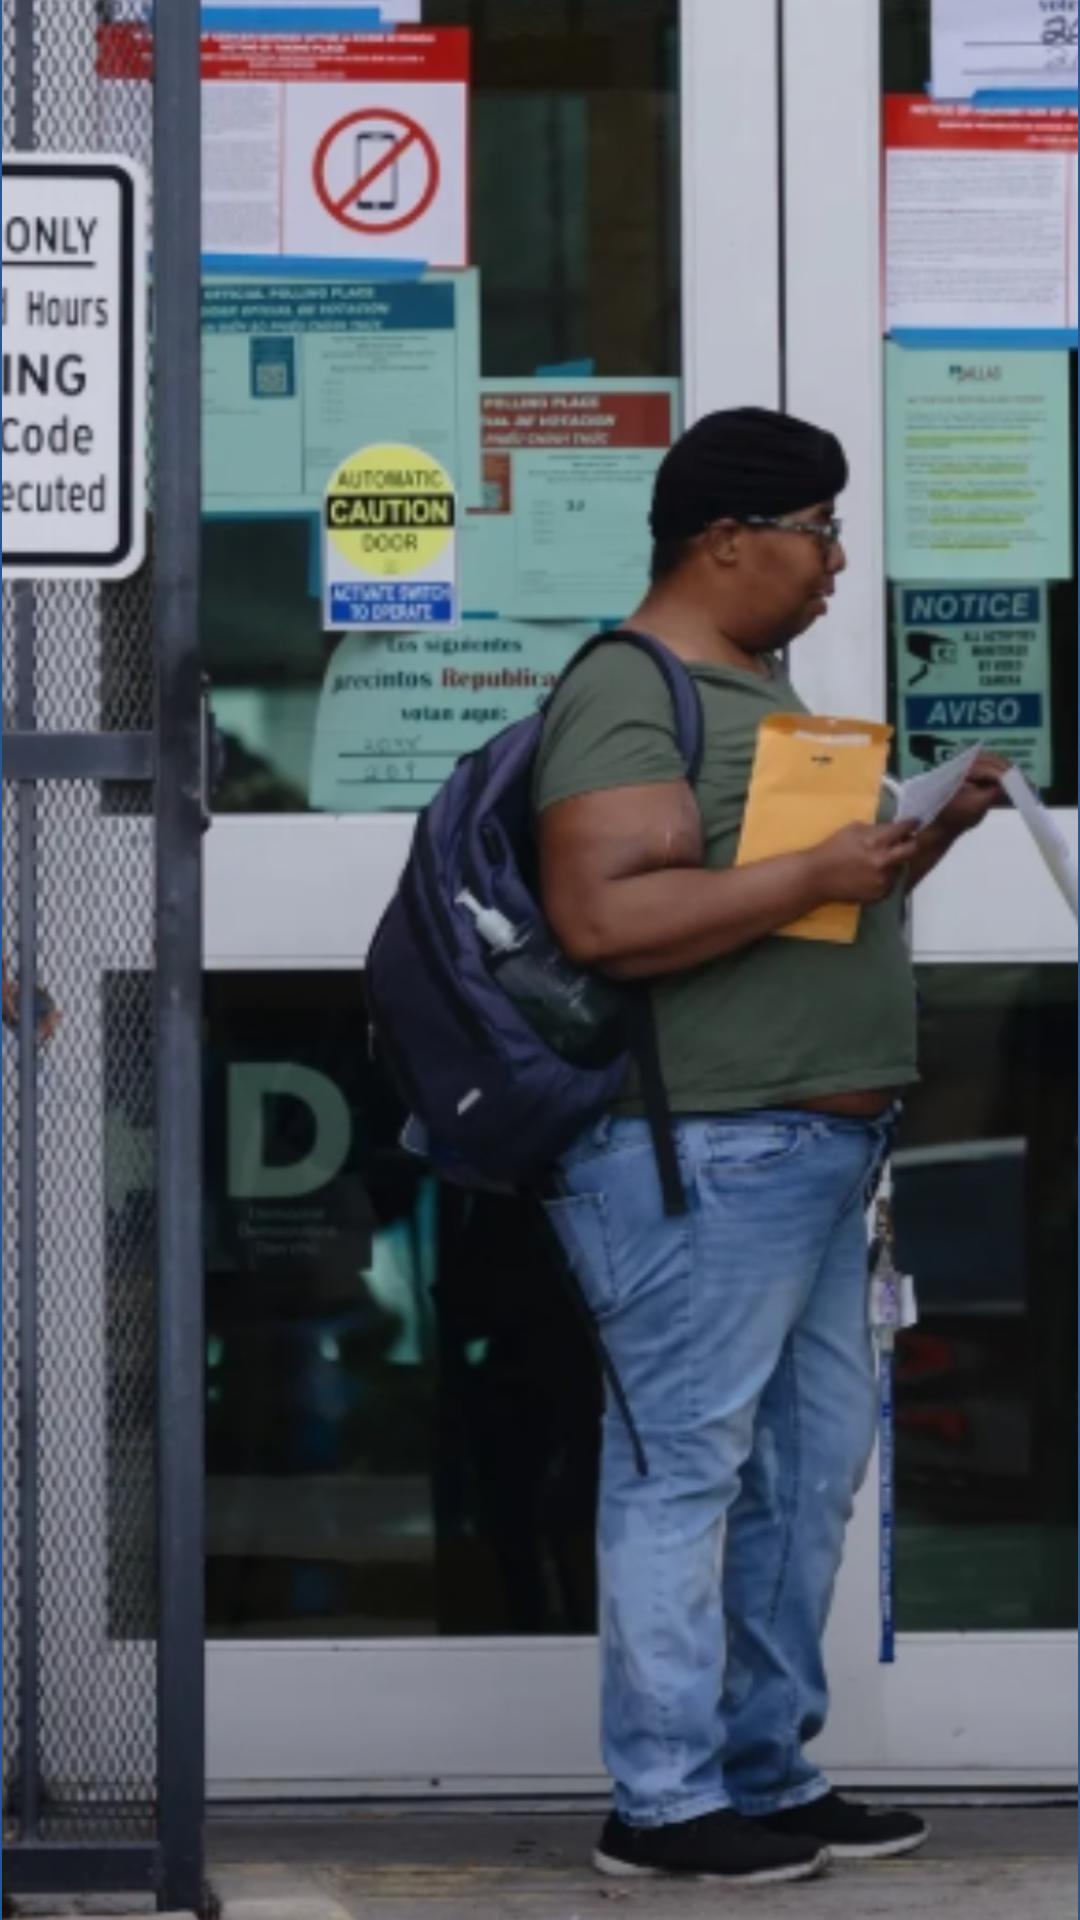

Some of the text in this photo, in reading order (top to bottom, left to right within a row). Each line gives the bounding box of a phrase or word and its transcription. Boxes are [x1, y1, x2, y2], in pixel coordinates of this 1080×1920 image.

[6, 216, 97, 254] ONLY
[331, 286, 374, 298] PLACE
[27, 290, 108, 327] Hours
[3, 353, 86, 395] ING
[551, 396, 600, 408] PLACE
[2, 414, 94, 454] Code
[338, 470, 443, 489] AUTOMATIC
[2, 475, 105, 513] ecuted
[330, 499, 449, 523] CAUTION
[361, 533, 418, 552] DOOR
[351, 604, 432, 619] TO OPERATE
[911, 592, 1029, 619] NOTICE
[424, 637, 522, 655] siguientes
[401, 707, 454, 721] votan
[927, 698, 1020, 725] AVISO
[228, 1062, 351, 1197] D
